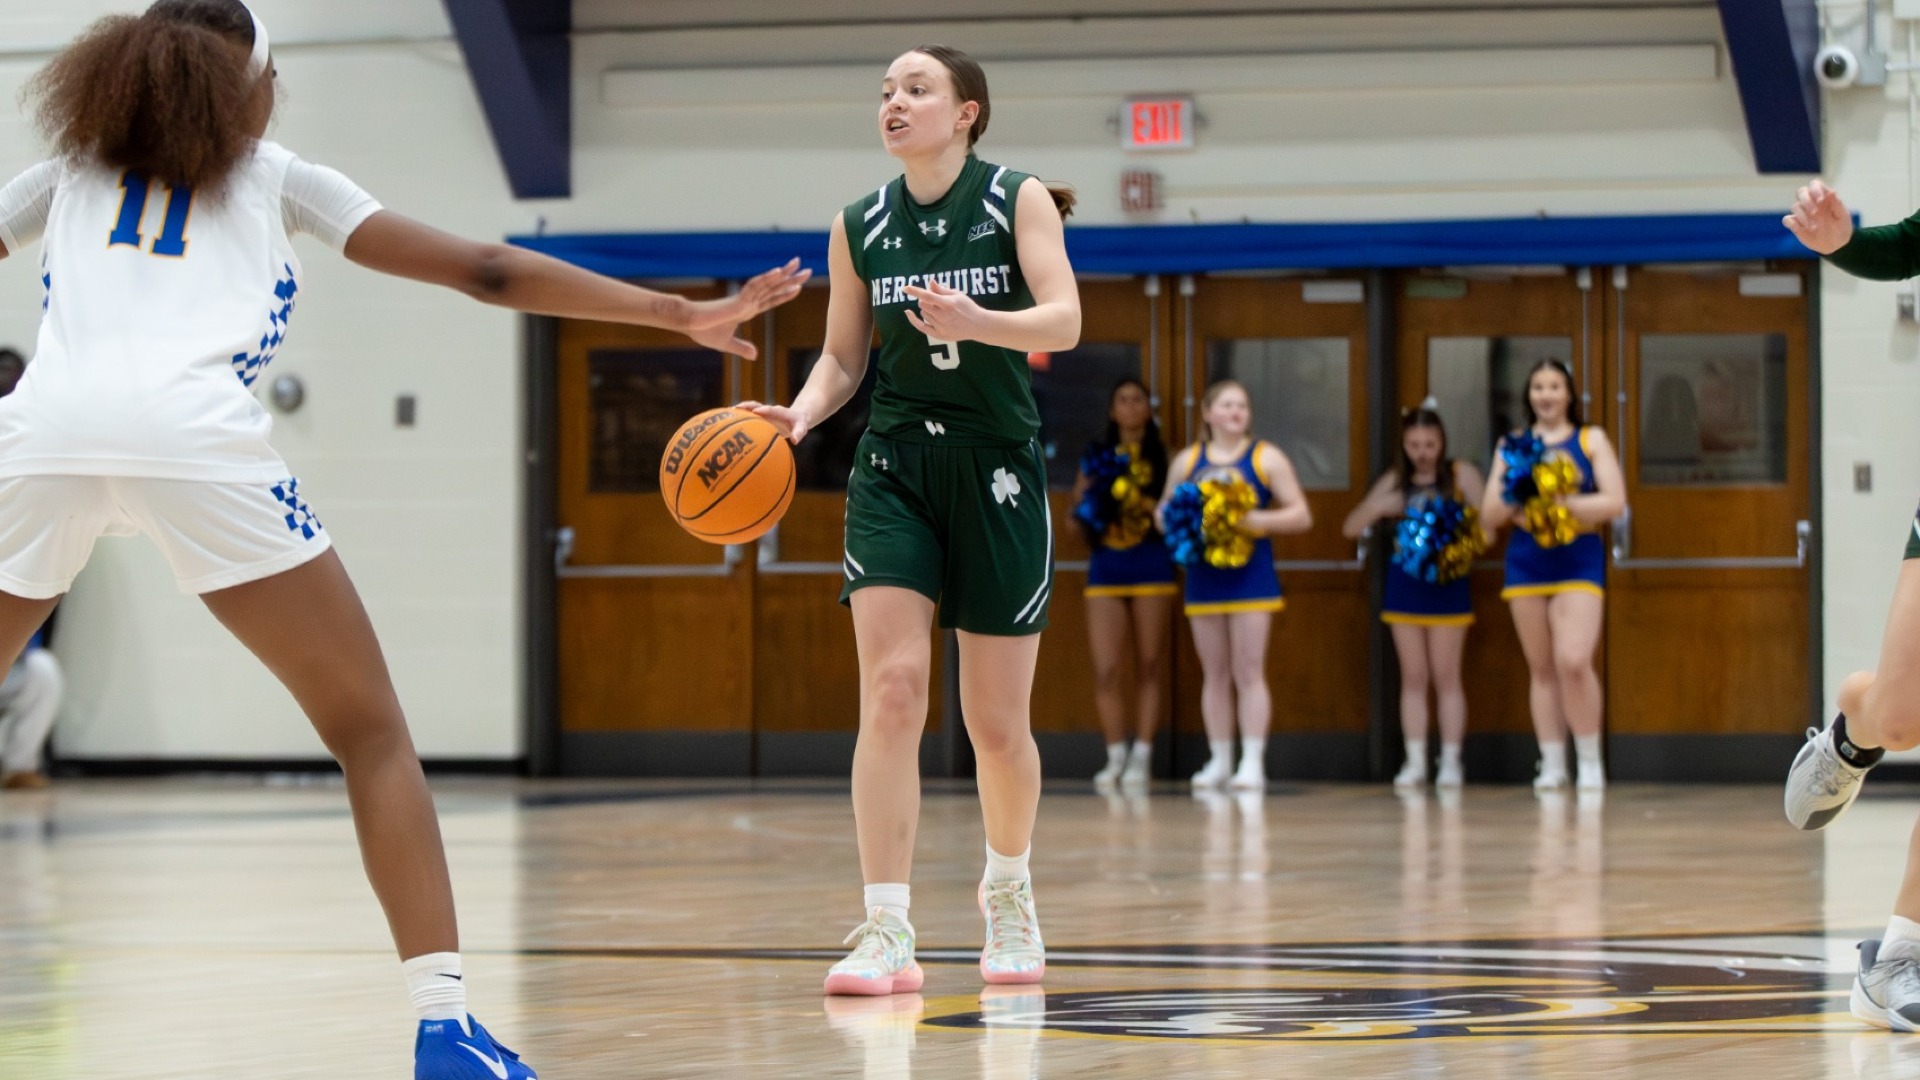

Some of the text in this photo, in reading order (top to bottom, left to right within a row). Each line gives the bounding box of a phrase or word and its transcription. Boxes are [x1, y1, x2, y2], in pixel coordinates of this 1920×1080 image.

[1132, 101, 1183, 144] EXIT
[107, 169, 195, 258] 11
[968, 218, 996, 240] NEC
[697, 430, 753, 489] NCAA
